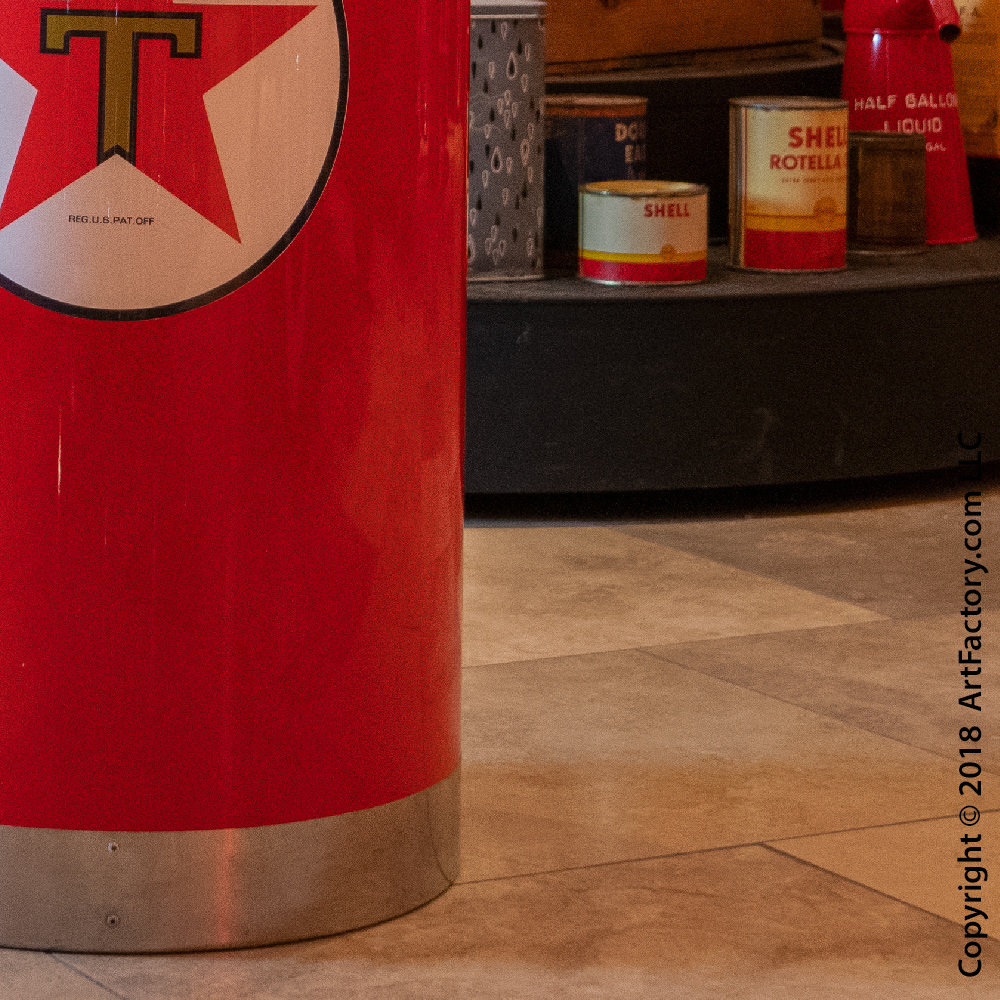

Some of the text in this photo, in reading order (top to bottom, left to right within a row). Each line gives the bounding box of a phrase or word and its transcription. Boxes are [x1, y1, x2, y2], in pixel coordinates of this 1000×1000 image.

[40, 8, 203, 167] T
[854, 94, 897, 112] HALF
[883, 116, 943, 134] LIQUID
[769, 153, 841, 171] ROTELLA
[643, 203, 690, 219] SHELL
